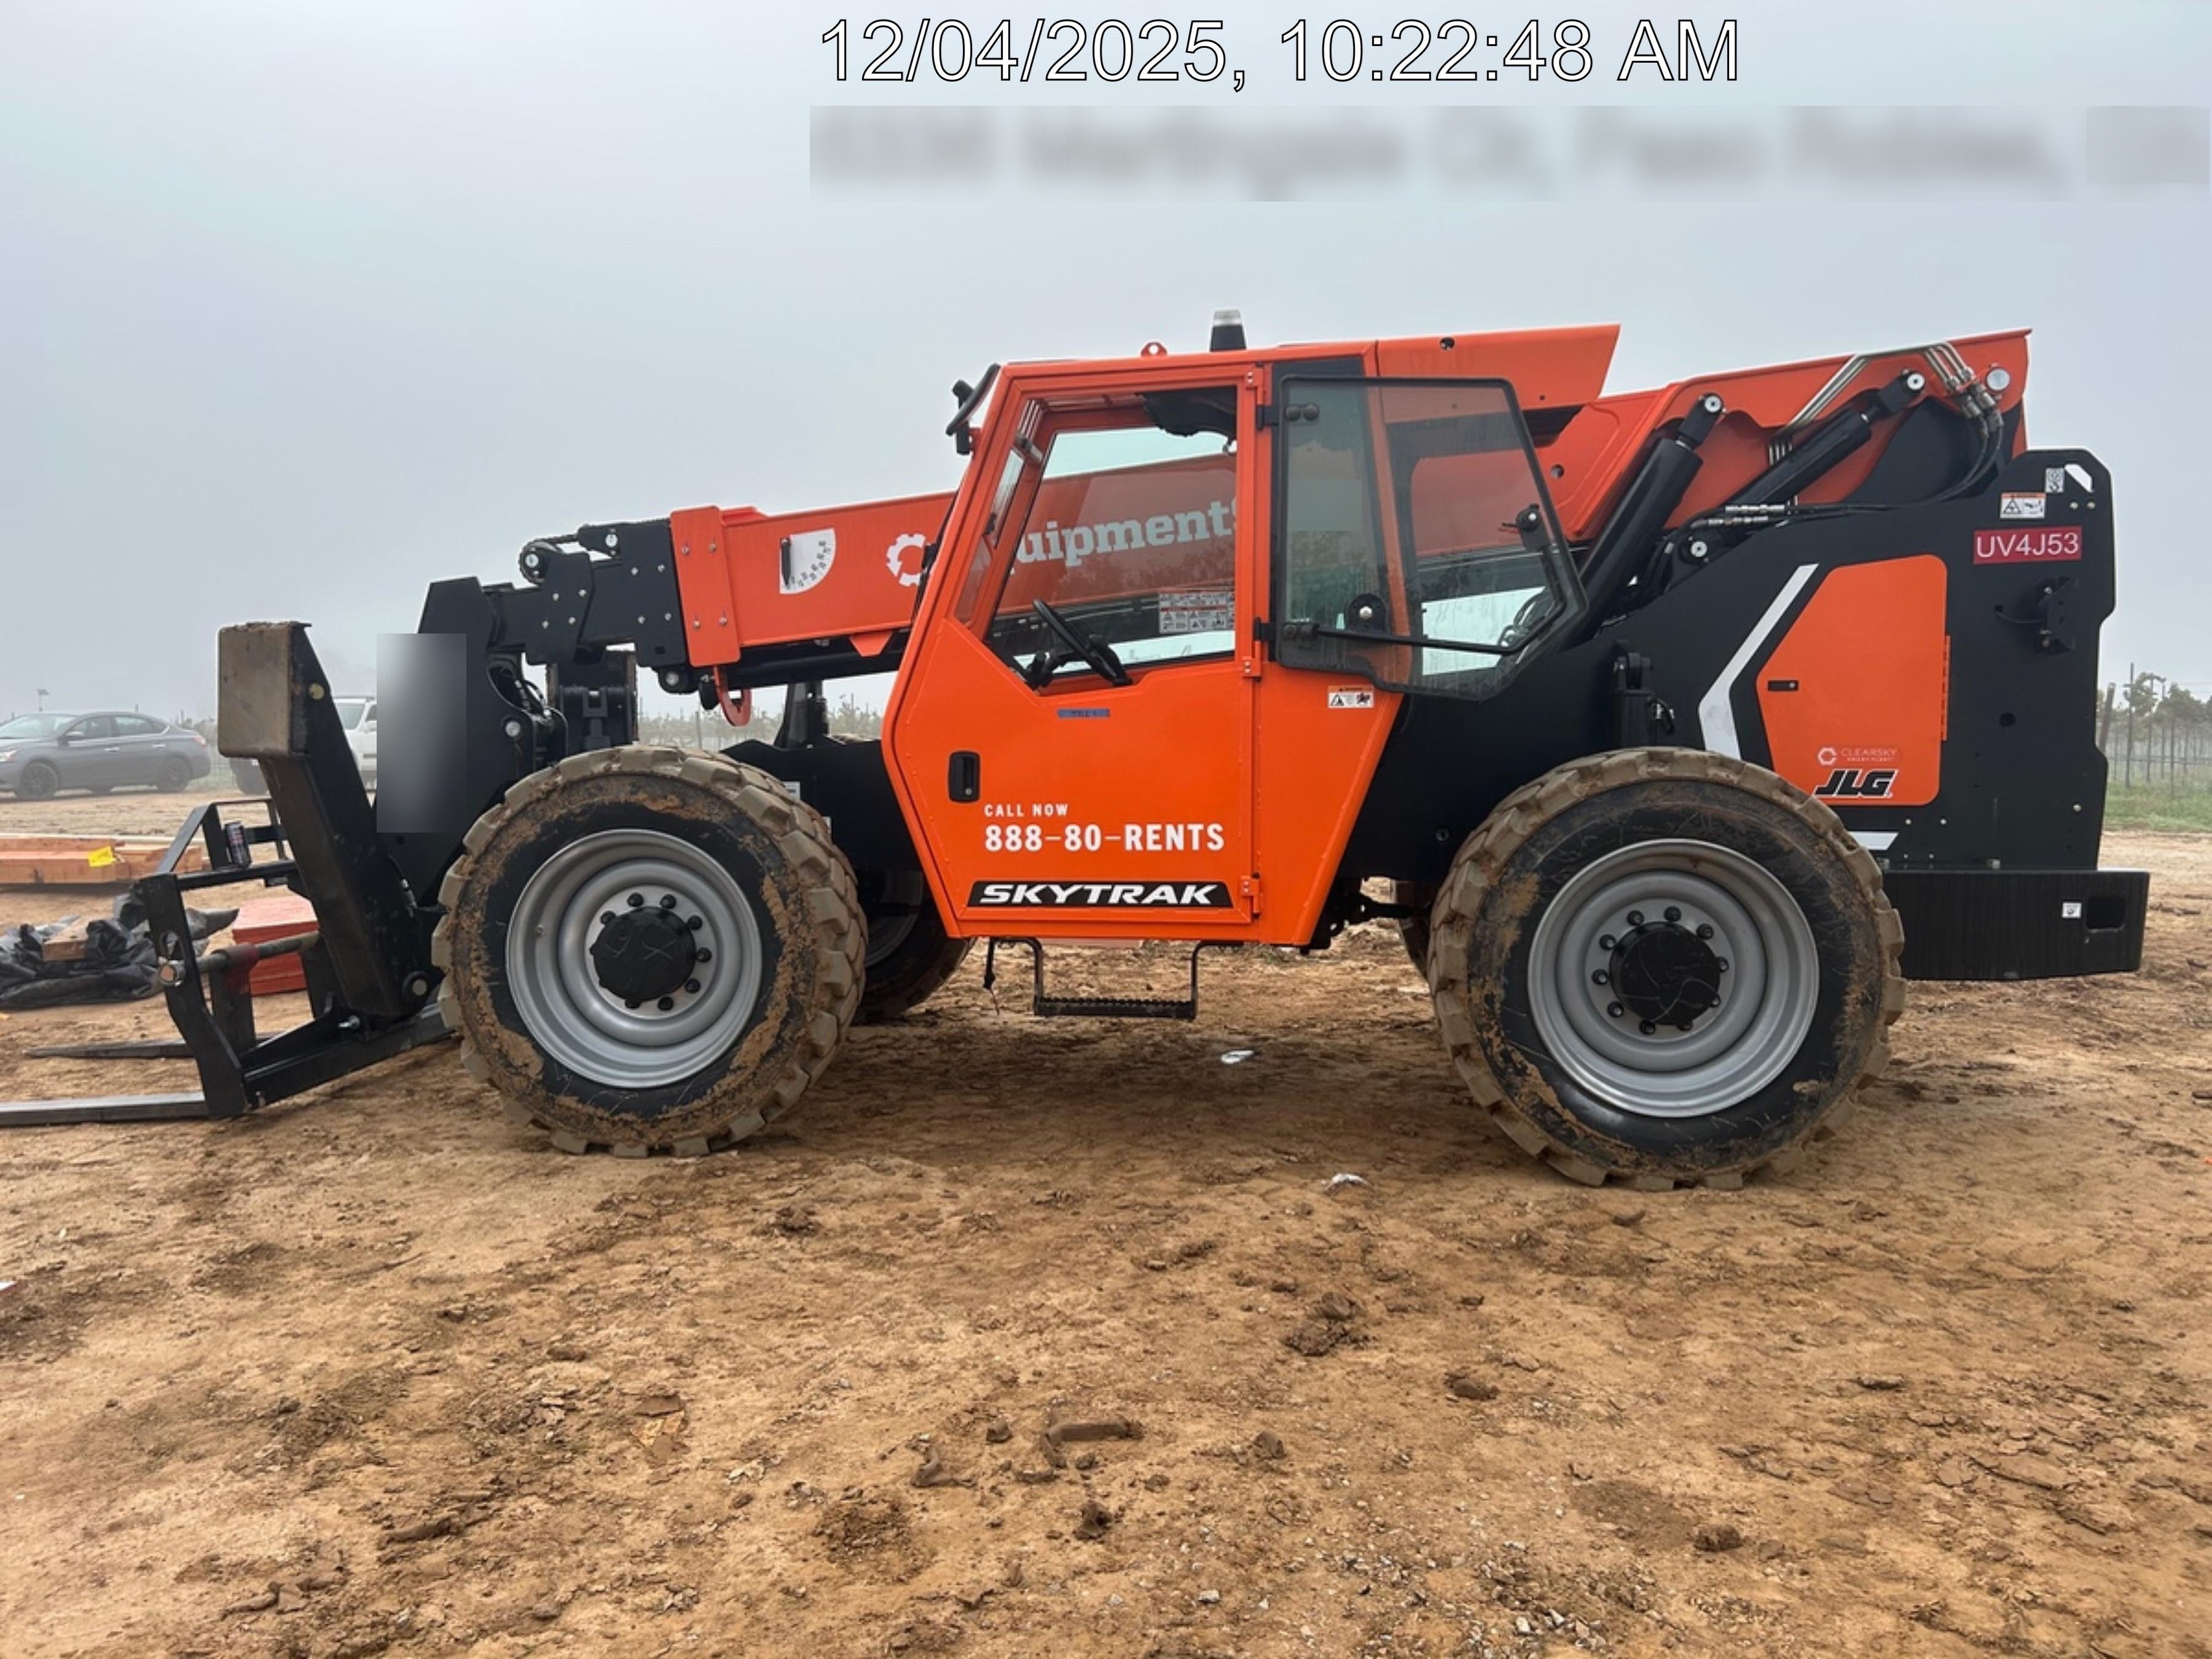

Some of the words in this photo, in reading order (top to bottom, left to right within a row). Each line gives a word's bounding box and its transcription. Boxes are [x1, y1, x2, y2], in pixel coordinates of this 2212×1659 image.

[1010, 498, 1235, 574] uipment
[1977, 533, 2079, 558] UV4J53
[1813, 768, 1899, 799] JLG
[984, 804, 1024, 817] CALL
[1032, 804, 1068, 816] NOW
[985, 823, 1224, 852] 888-80-RENTS
[980, 884, 1217, 904] SKYTRAK
